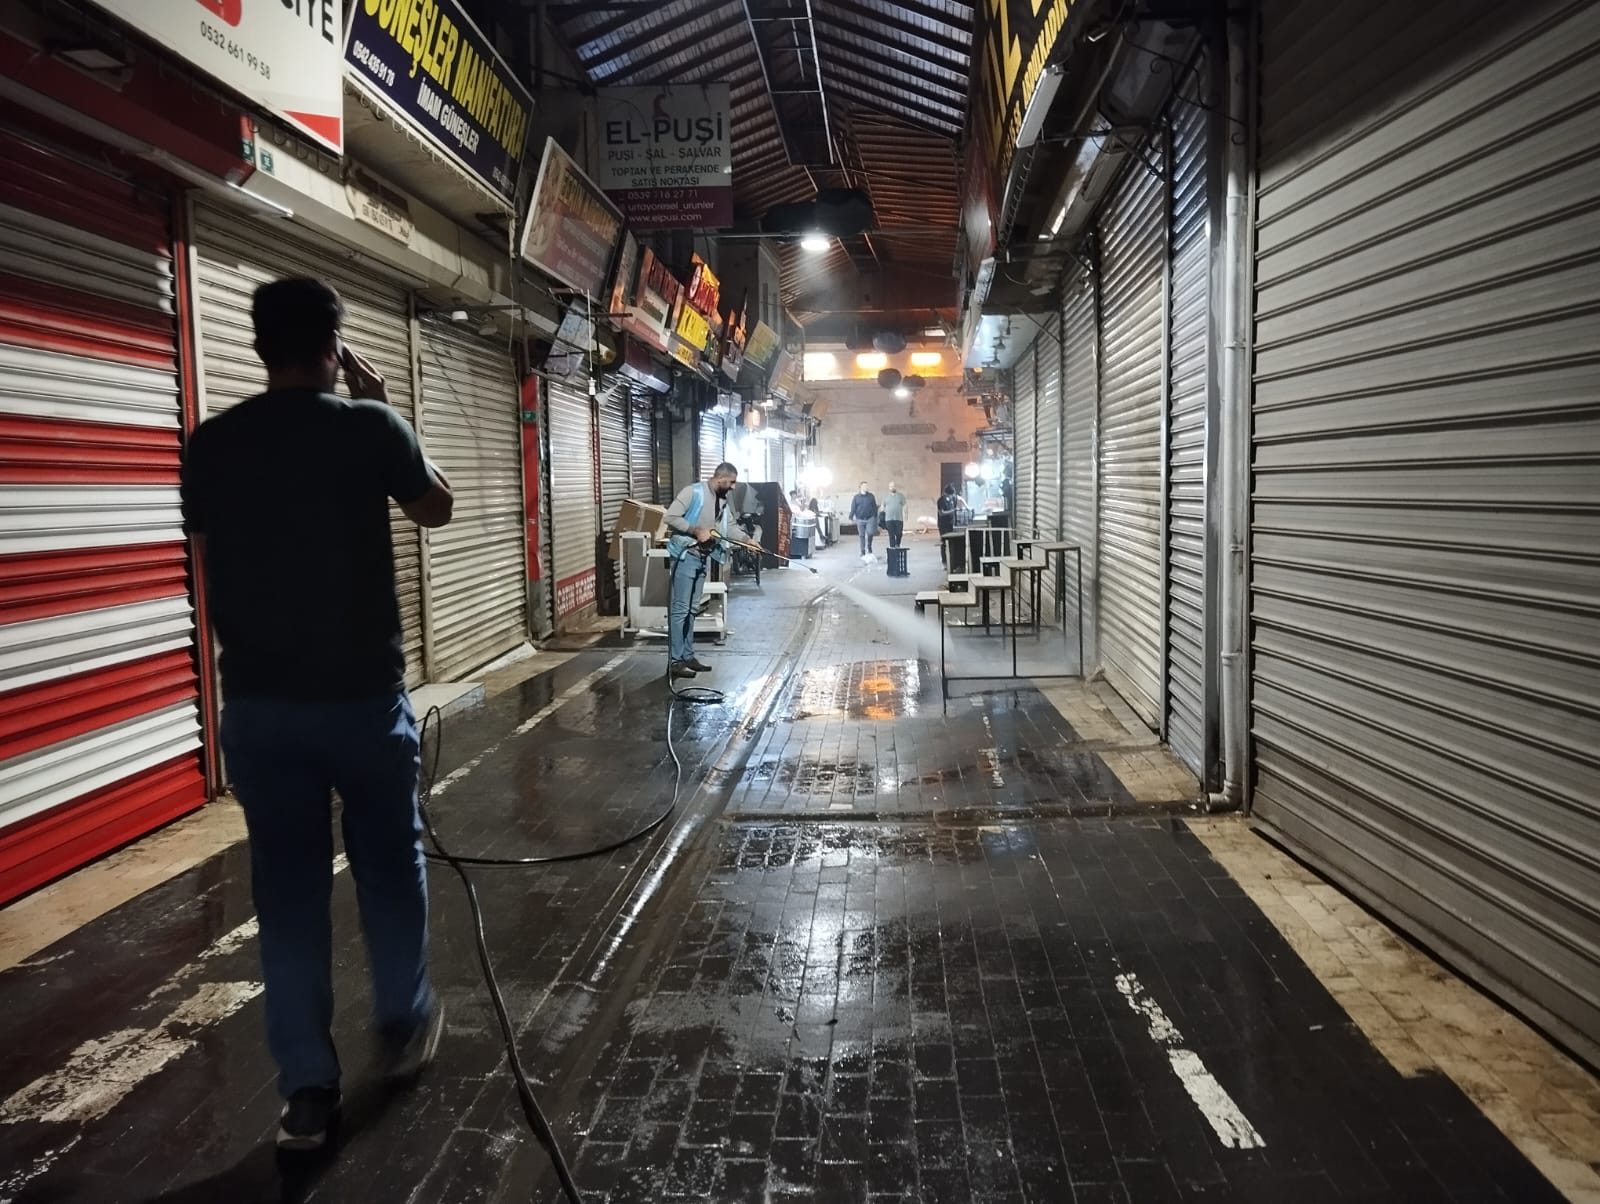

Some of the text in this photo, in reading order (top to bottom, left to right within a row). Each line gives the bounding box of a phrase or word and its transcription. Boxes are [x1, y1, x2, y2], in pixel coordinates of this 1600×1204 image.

[200, 21, 272, 80] 0532 661 99 58
[416, 76, 480, 154] İMAM GÜNEŞLER
[606, 112, 723, 145] EL-PUŞİ
[611, 167, 648, 177] TOPTAN
[664, 163, 720, 175] PERAKENDE
